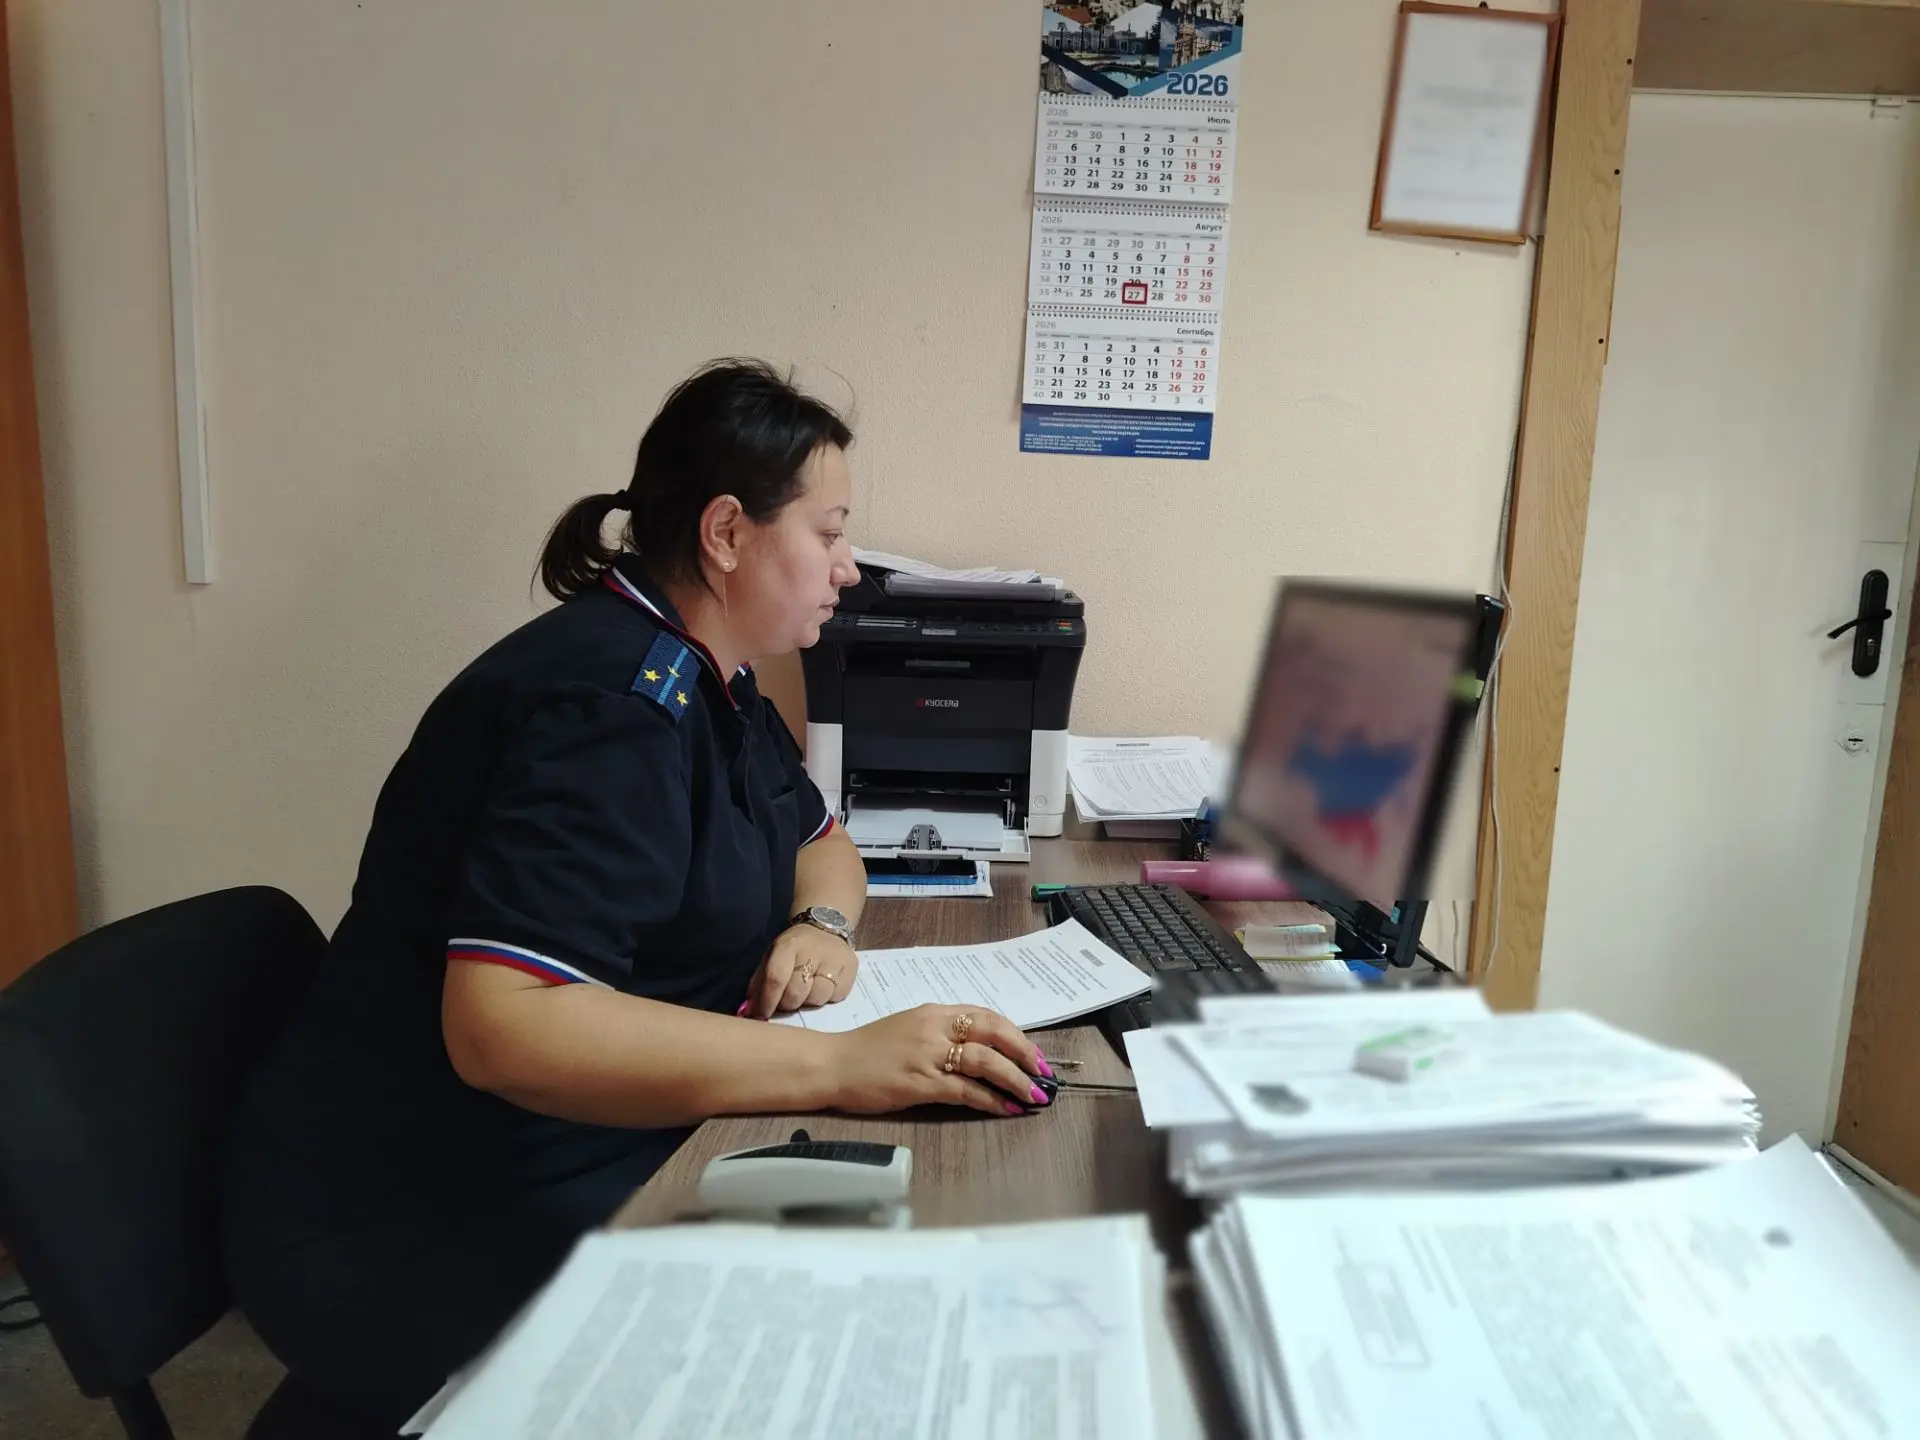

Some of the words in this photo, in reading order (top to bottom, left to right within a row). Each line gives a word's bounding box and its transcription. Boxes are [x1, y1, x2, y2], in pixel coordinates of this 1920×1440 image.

[1166, 72, 1229, 97] 2026
[1046, 108, 1069, 118] 2026
[1207, 115, 1231, 126] Июль
[1065, 129, 1079, 138] 29
[1089, 130, 1103, 140] 30
[1120, 132, 1126, 141] 1
[1144, 133, 1151, 142] 2
[1168, 134, 1174, 143] 3
[1192, 136, 1199, 144] 4
[1216, 136, 1223, 146] 5
[1071, 143, 1078, 152] 6
[1095, 144, 1102, 153] 7
[1119, 145, 1126, 154] 8
[1143, 146, 1150, 155] 9
[1162, 147, 1174, 156] 10
[1186, 148, 1197, 157] 11
[1210, 149, 1222, 158] 12
[1065, 155, 1077, 164] 13
[1089, 156, 1101, 165] 14
[1113, 158, 1125, 167] 15
[1137, 159, 1149, 168] 16
[1161, 160, 1173, 169] 17
[1185, 161, 1197, 170] 18
[1209, 162, 1222, 171] 19
[1064, 168, 1076, 177] 20
[1087, 169, 1099, 177] 21
[1111, 170, 1124, 179] 22
[1136, 171, 1148, 180] 23
[1160, 173, 1172, 181] 24
[1183, 174, 1196, 183] 25
[1208, 175, 1221, 184] 26
[1063, 180, 1076, 188] 27
[1087, 181, 1100, 189] 28
[1111, 182, 1124, 190] 29
[1135, 184, 1148, 192] 30
[1159, 185, 1171, 193] 31
[1213, 187, 1220, 196] 2
[1040, 216, 1063, 224] 2026
[1195, 223, 1223, 232] Август
[1059, 236, 1072, 245] 27
[1083, 237, 1096, 247] 28
[1107, 239, 1120, 248] 29
[1131, 240, 1144, 249] 30
[1155, 241, 1167, 250] 31
[1185, 243, 1191, 251] 1
[1209, 243, 1215, 252] 2
[1065, 250, 1071, 258] 3
[1088, 251, 1095, 259] 4
[1112, 252, 1119, 261] 5
[1136, 253, 1143, 262] 6
[1160, 254, 1167, 263] 7
[1183, 255, 1190, 264] 8
[1207, 256, 1215, 265] 9
[1059, 262, 1071, 271] 10
[1082, 263, 1093, 272] 11
[1106, 264, 1118, 274] 12
[1130, 266, 1142, 275] 13
[1154, 267, 1166, 275] 14
[1177, 268, 1189, 277] 15
[1201, 269, 1214, 278] 16
[1058, 275, 1070, 283] 17
[1082, 276, 1094, 285] 18
[1105, 277, 1118, 286] 19
[1152, 279, 1164, 288] 21
[1176, 280, 1188, 290] 22
[1199, 281, 1212, 291] 23
[1080, 288, 1093, 298] 25
[1104, 290, 1117, 299] 26
[1127, 291, 1140, 300] 27
[1151, 292, 1164, 301] 28
[1174, 293, 1188, 302] 29
[1199, 294, 1212, 303] 30
[1034, 321, 1057, 329] 2026
[1176, 327, 1215, 338] Сентябрь
[1053, 341, 1065, 350] 31
[1083, 343, 1088, 351] 1
[1107, 344, 1113, 352] 2
[1130, 344, 1136, 353] 3
[1153, 346, 1160, 354] 4
[1177, 346, 1184, 355] 5
[1200, 348, 1207, 356] 6
[1059, 354, 1065, 362] 7
[1082, 355, 1089, 364] 8
[1105, 356, 1112, 365] 9
[1124, 357, 1136, 366] 10
[1147, 358, 1158, 366] 11
[1171, 359, 1183, 368] 12
[1194, 360, 1206, 369] 13
[1053, 366, 1064, 374] 14
[1076, 367, 1088, 376] 15
[1100, 368, 1112, 377] 16
[1123, 369, 1135, 378] 17
[1147, 370, 1158, 379] 18
[1170, 371, 1182, 380] 19
[1193, 372, 1206, 381] 20
[1051, 378, 1063, 387] 21
[1074, 379, 1087, 388] 22
[1098, 380, 1111, 389] 23
[1122, 382, 1134, 390] 24
[1145, 383, 1158, 391] 25
[1168, 384, 1181, 393] 26
[1192, 385, 1205, 393] 27
[1050, 390, 1063, 399] 28
[1074, 392, 1087, 400] 29
[1097, 392, 1110, 401] 30
[1151, 395, 1157, 403] 2
[1174, 396, 1180, 405] 3
[1197, 397, 1204, 406] 4
[924, 699, 960, 708] KYOCERA
